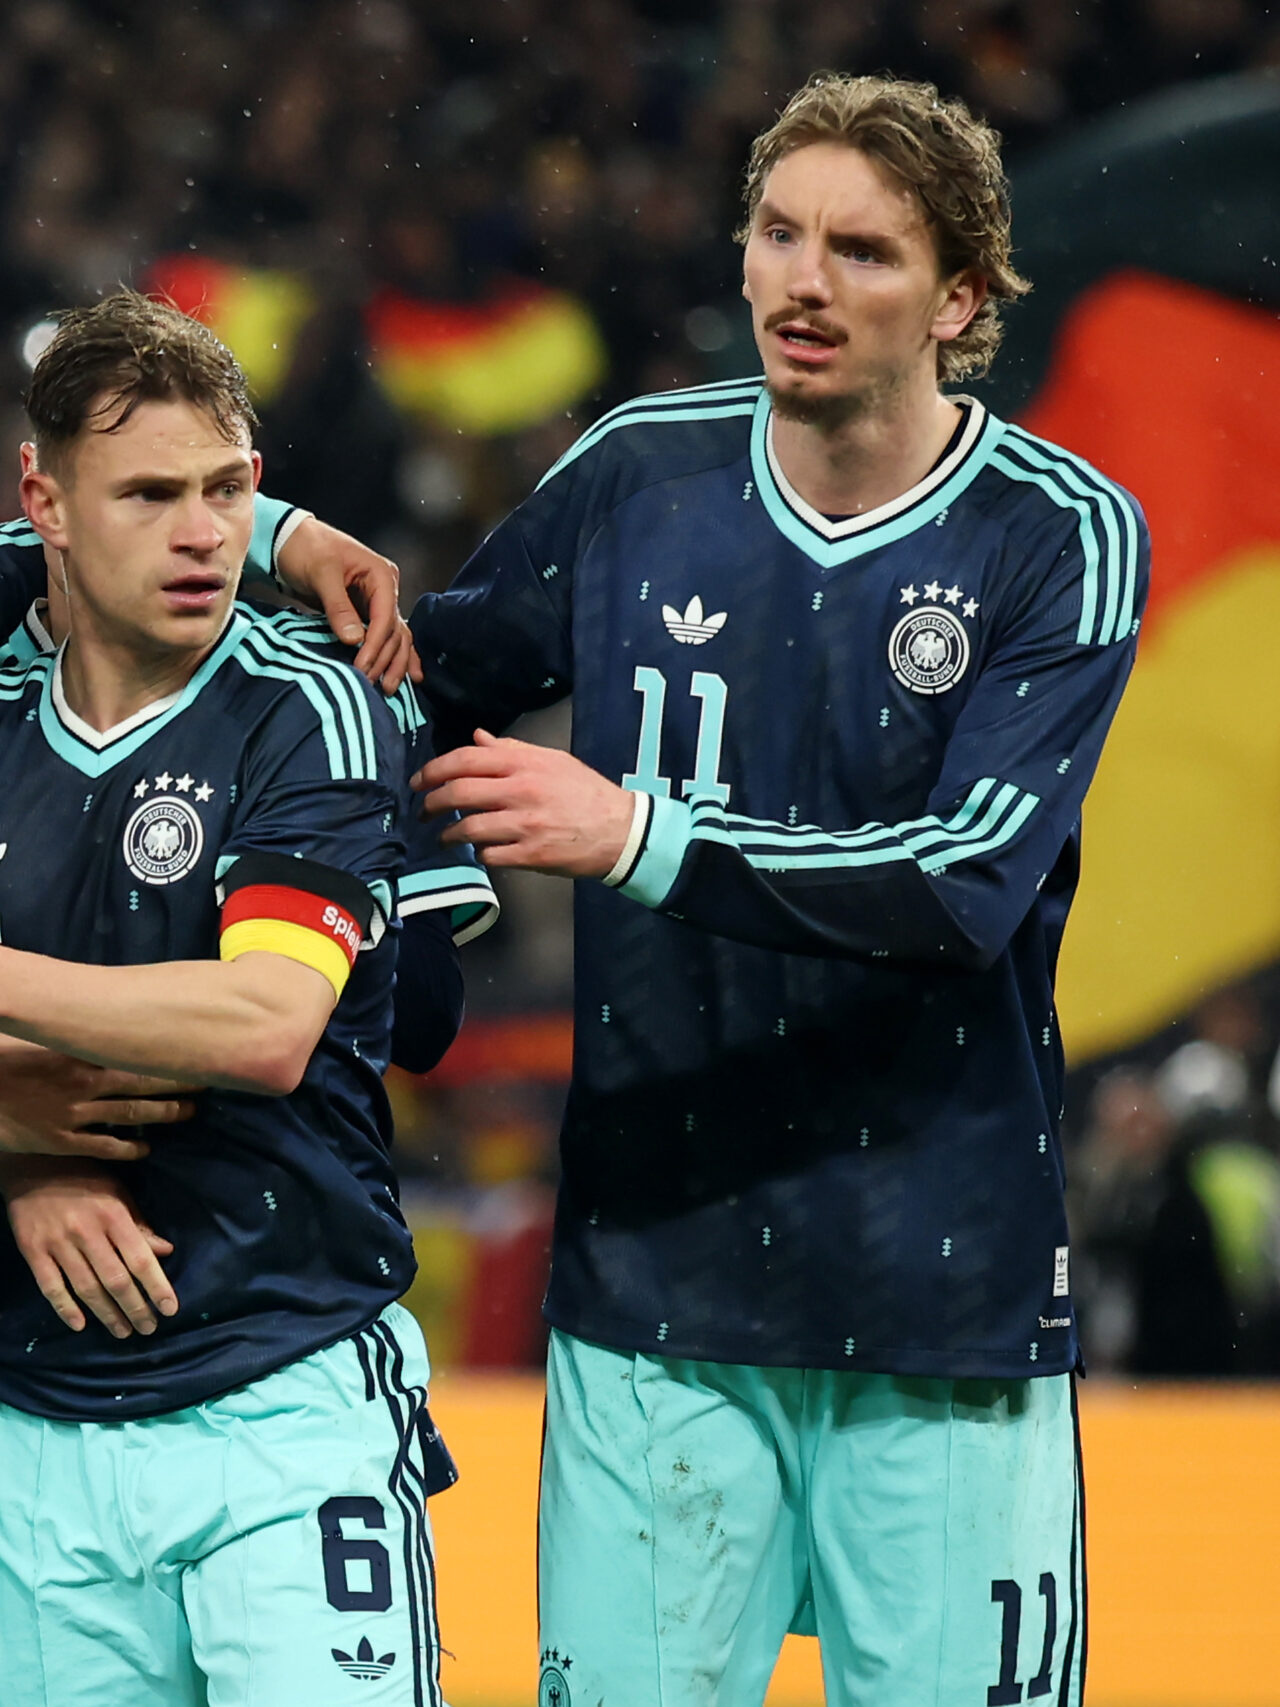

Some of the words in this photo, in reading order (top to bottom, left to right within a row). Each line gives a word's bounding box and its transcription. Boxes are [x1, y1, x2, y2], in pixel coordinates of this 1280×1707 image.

[910, 618, 955, 639] DEUTSCHER
[900, 654, 954, 683] FUSSBALL-BUND
[622, 665, 731, 804] 11
[143, 807, 187, 825] DEUTSCHER
[134, 847, 188, 872] FUSSBALL-BUND
[317, 1496, 393, 1612] 6
[987, 1571, 1056, 1707] 11
